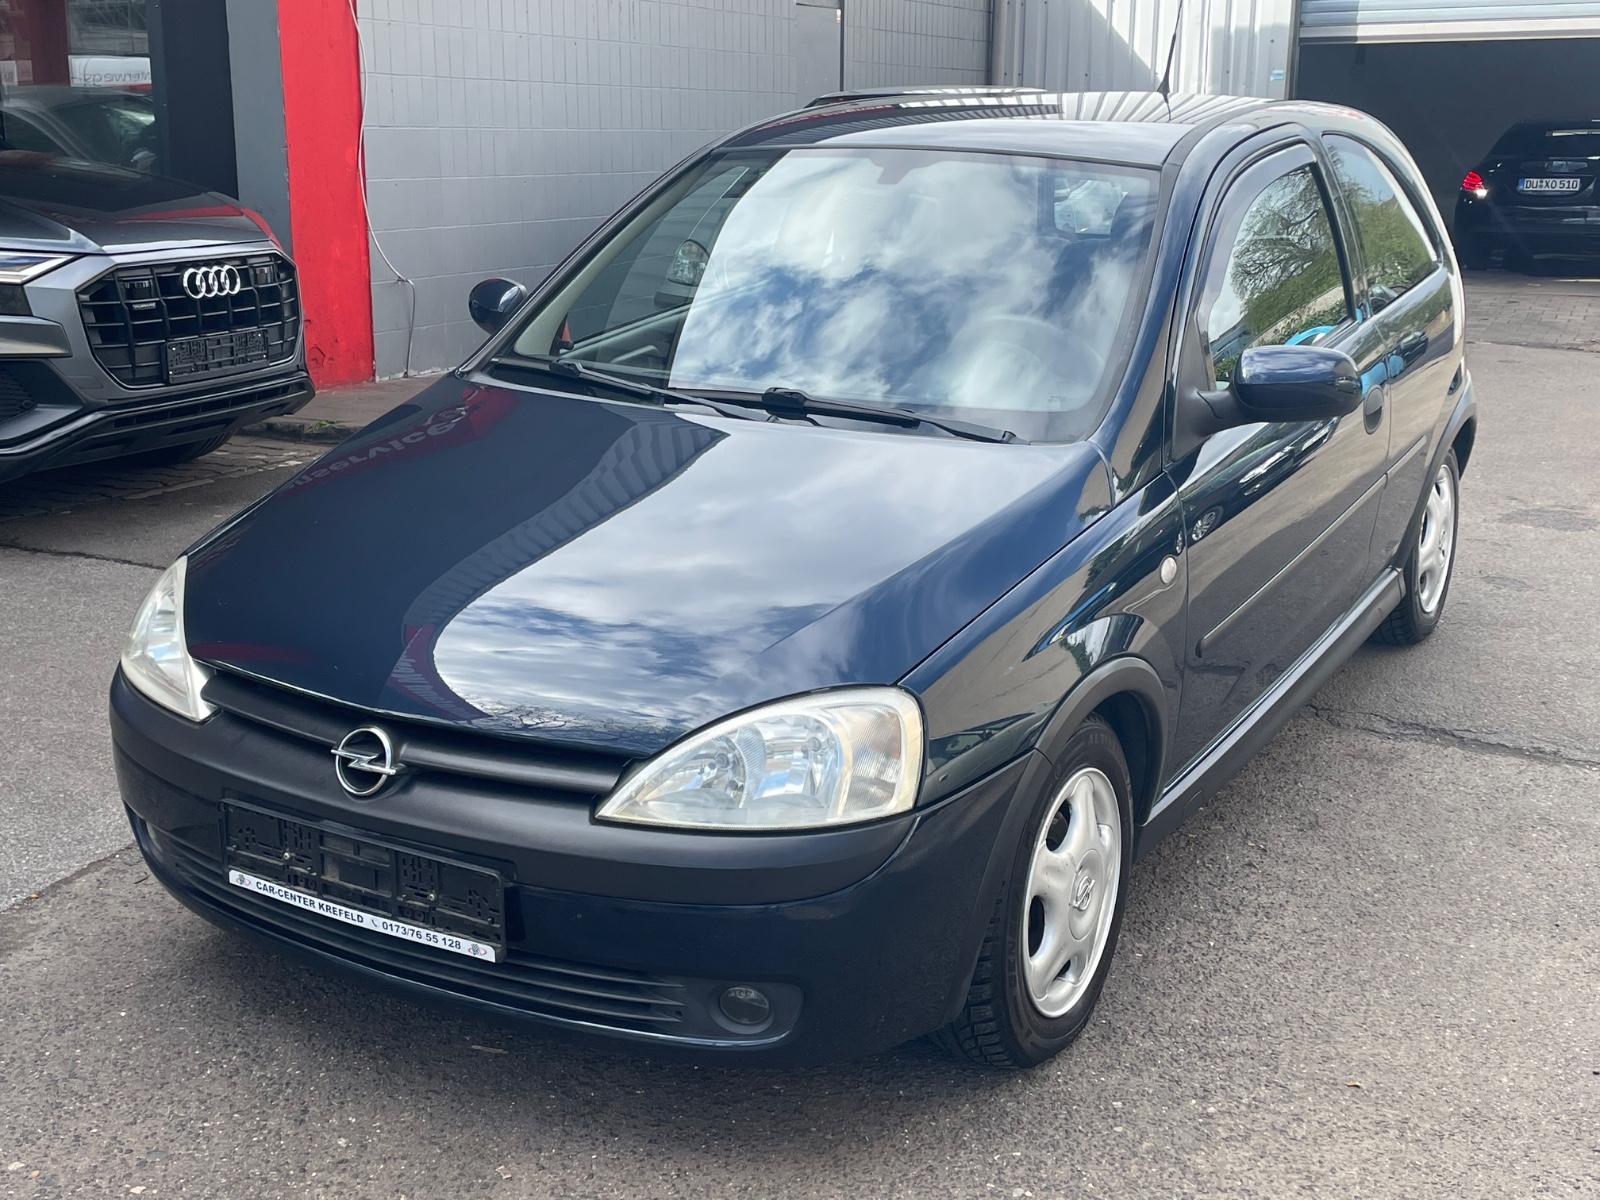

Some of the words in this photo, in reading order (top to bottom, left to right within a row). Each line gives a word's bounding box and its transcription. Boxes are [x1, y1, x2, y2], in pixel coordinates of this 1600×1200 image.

[1525, 179, 1539, 189] DU
[1558, 179, 1578, 189] 510
[317, 901, 364, 923] KREFELD
[381, 921, 423, 940] 0173/76
[425, 932, 439, 944] 55
[441, 936, 462, 950] 128
